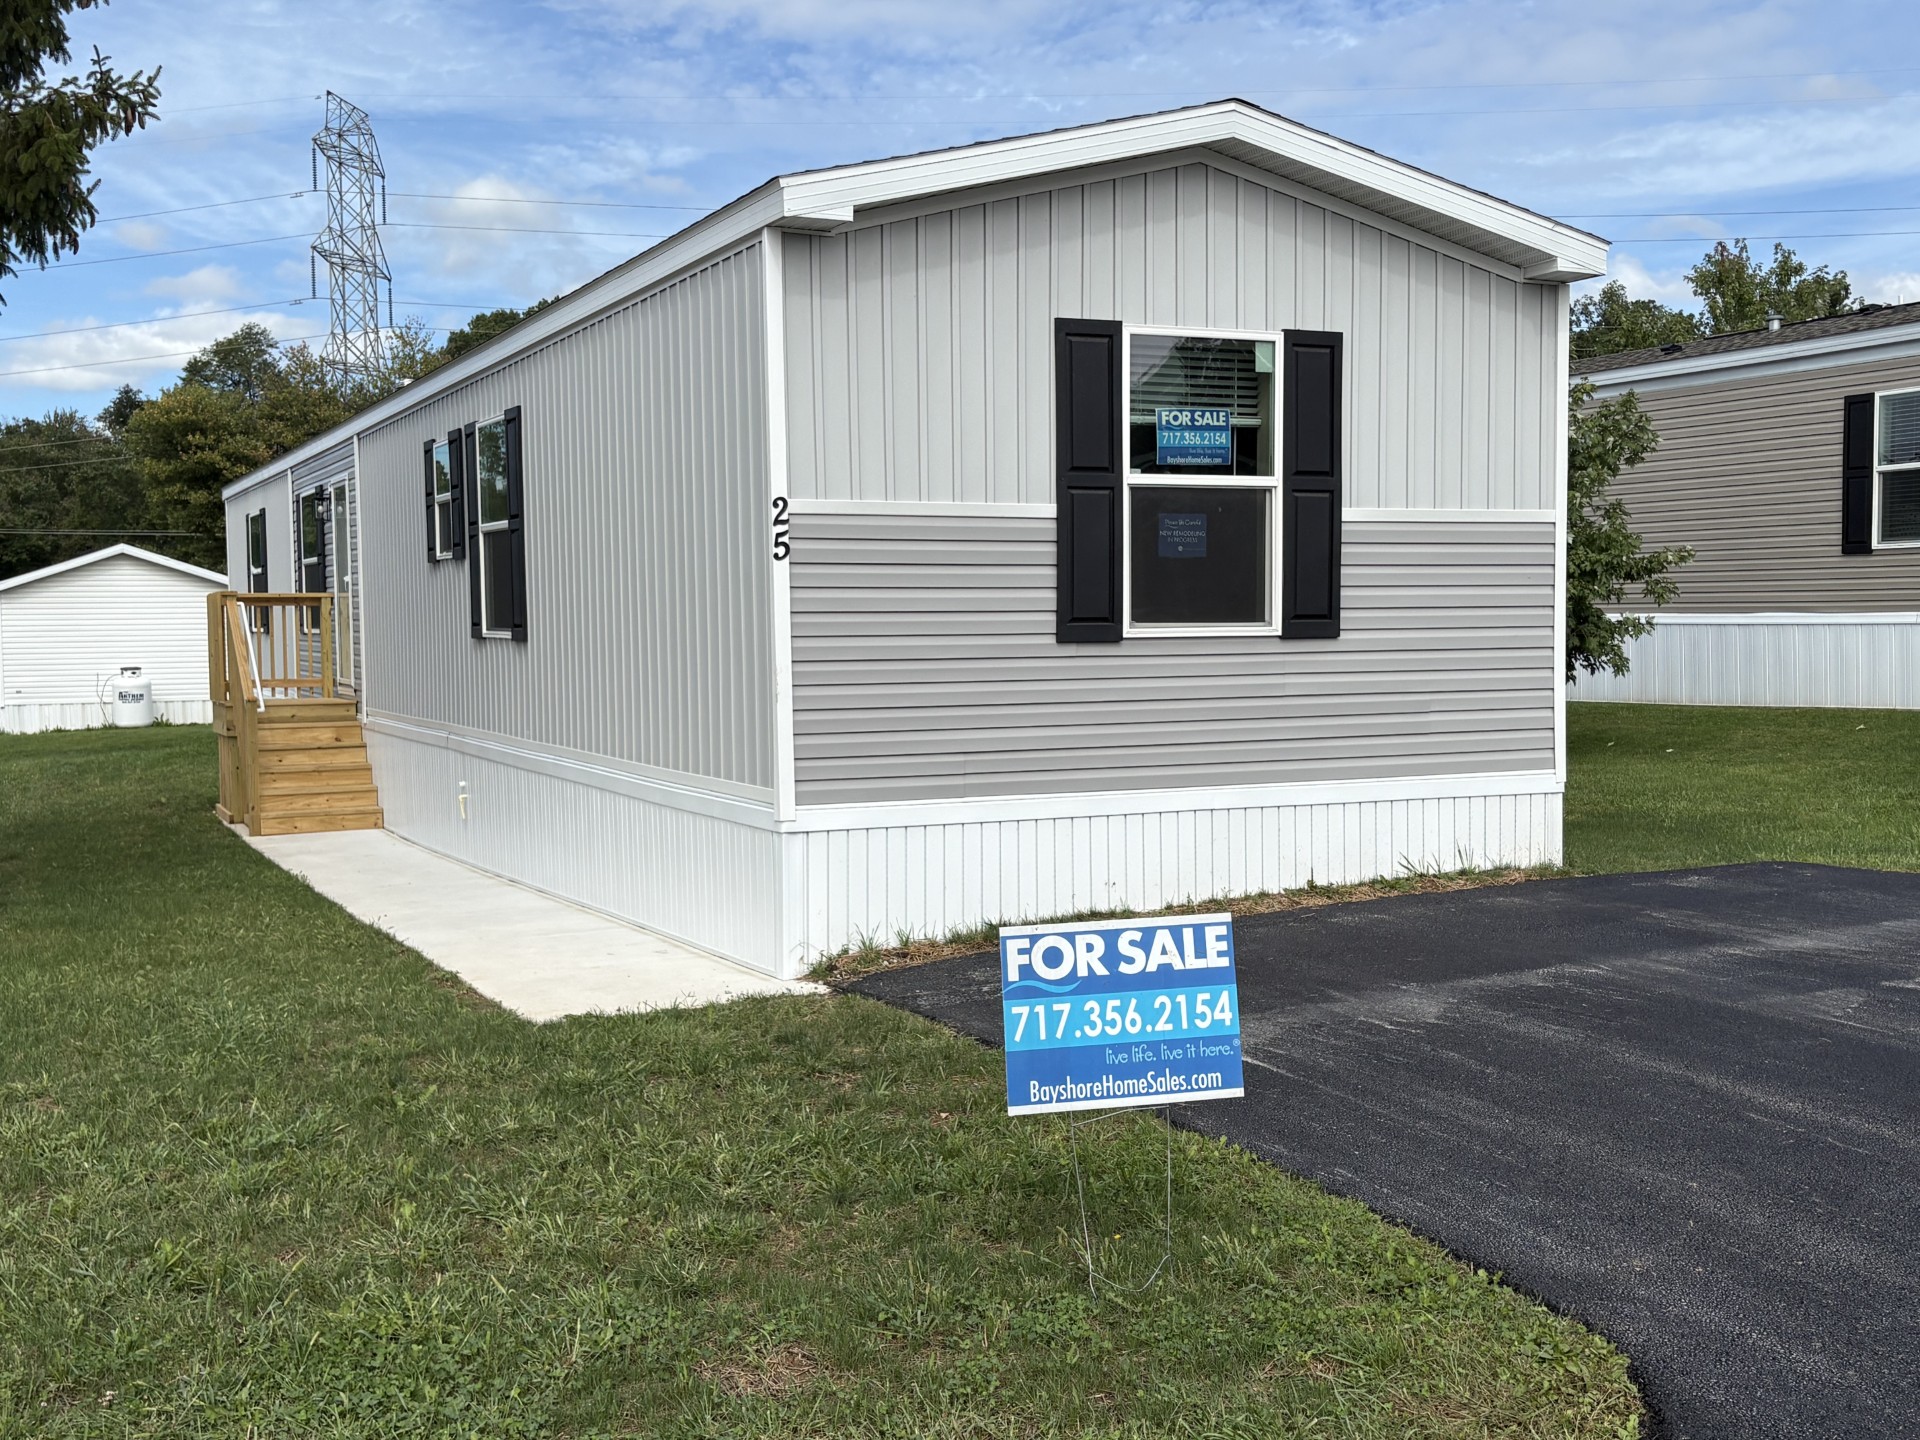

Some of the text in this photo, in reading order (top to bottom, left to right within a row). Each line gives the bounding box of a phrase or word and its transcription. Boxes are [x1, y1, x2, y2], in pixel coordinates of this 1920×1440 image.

[1161, 411, 1227, 426] FOR SALE
[1162, 432, 1226, 445] 717.356.2154
[772, 496, 791, 562] 25
[1006, 925, 1230, 982] FOR SALE
[1011, 990, 1233, 1043] 717.356.2154
[1105, 1047, 1128, 1065] live
[1131, 1044, 1157, 1063] life.
[1160, 1043, 1183, 1060] live
[1186, 1043, 1196, 1058] it
[1029, 1067, 1222, 1104] BayshoreHomeSales.com
